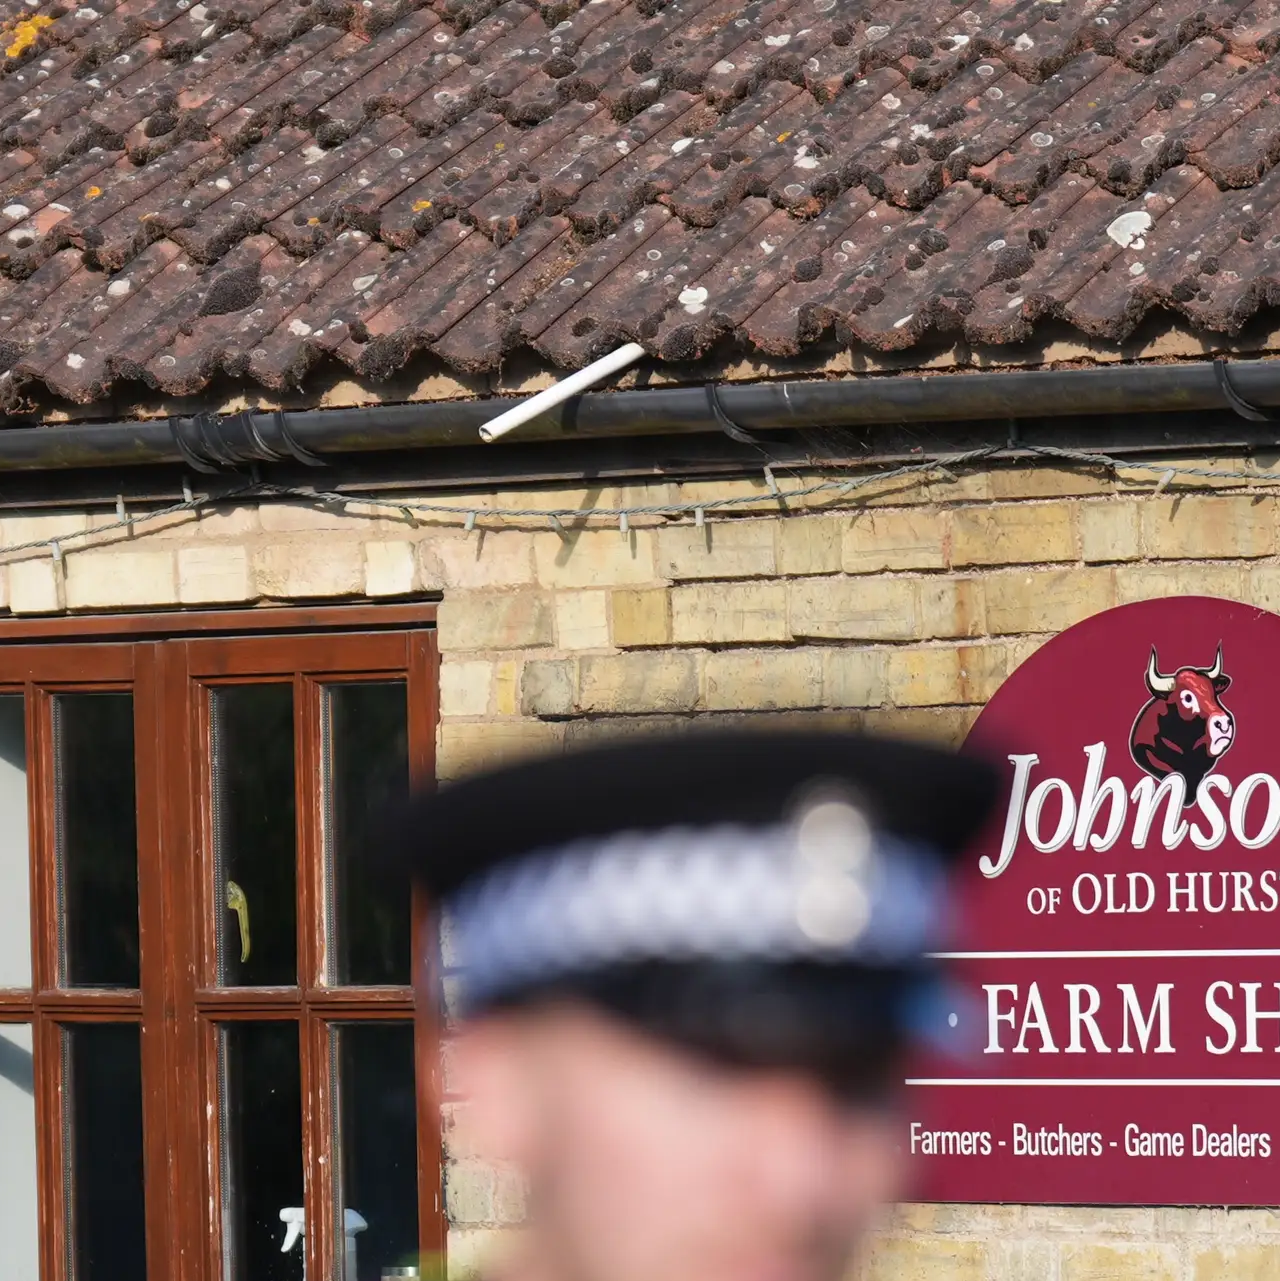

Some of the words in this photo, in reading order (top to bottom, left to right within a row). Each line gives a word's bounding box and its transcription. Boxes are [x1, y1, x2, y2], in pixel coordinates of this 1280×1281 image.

[1026, 887, 1062, 915] OF
[1071, 872, 1156, 915] OLD
[981, 981, 1177, 1055] FARM
[909, 1122, 993, 1157] Farmers
[1012, 1122, 1103, 1157] Butchers
[1124, 1122, 1185, 1158] Game
[1191, 1123, 1272, 1158] Dealers
